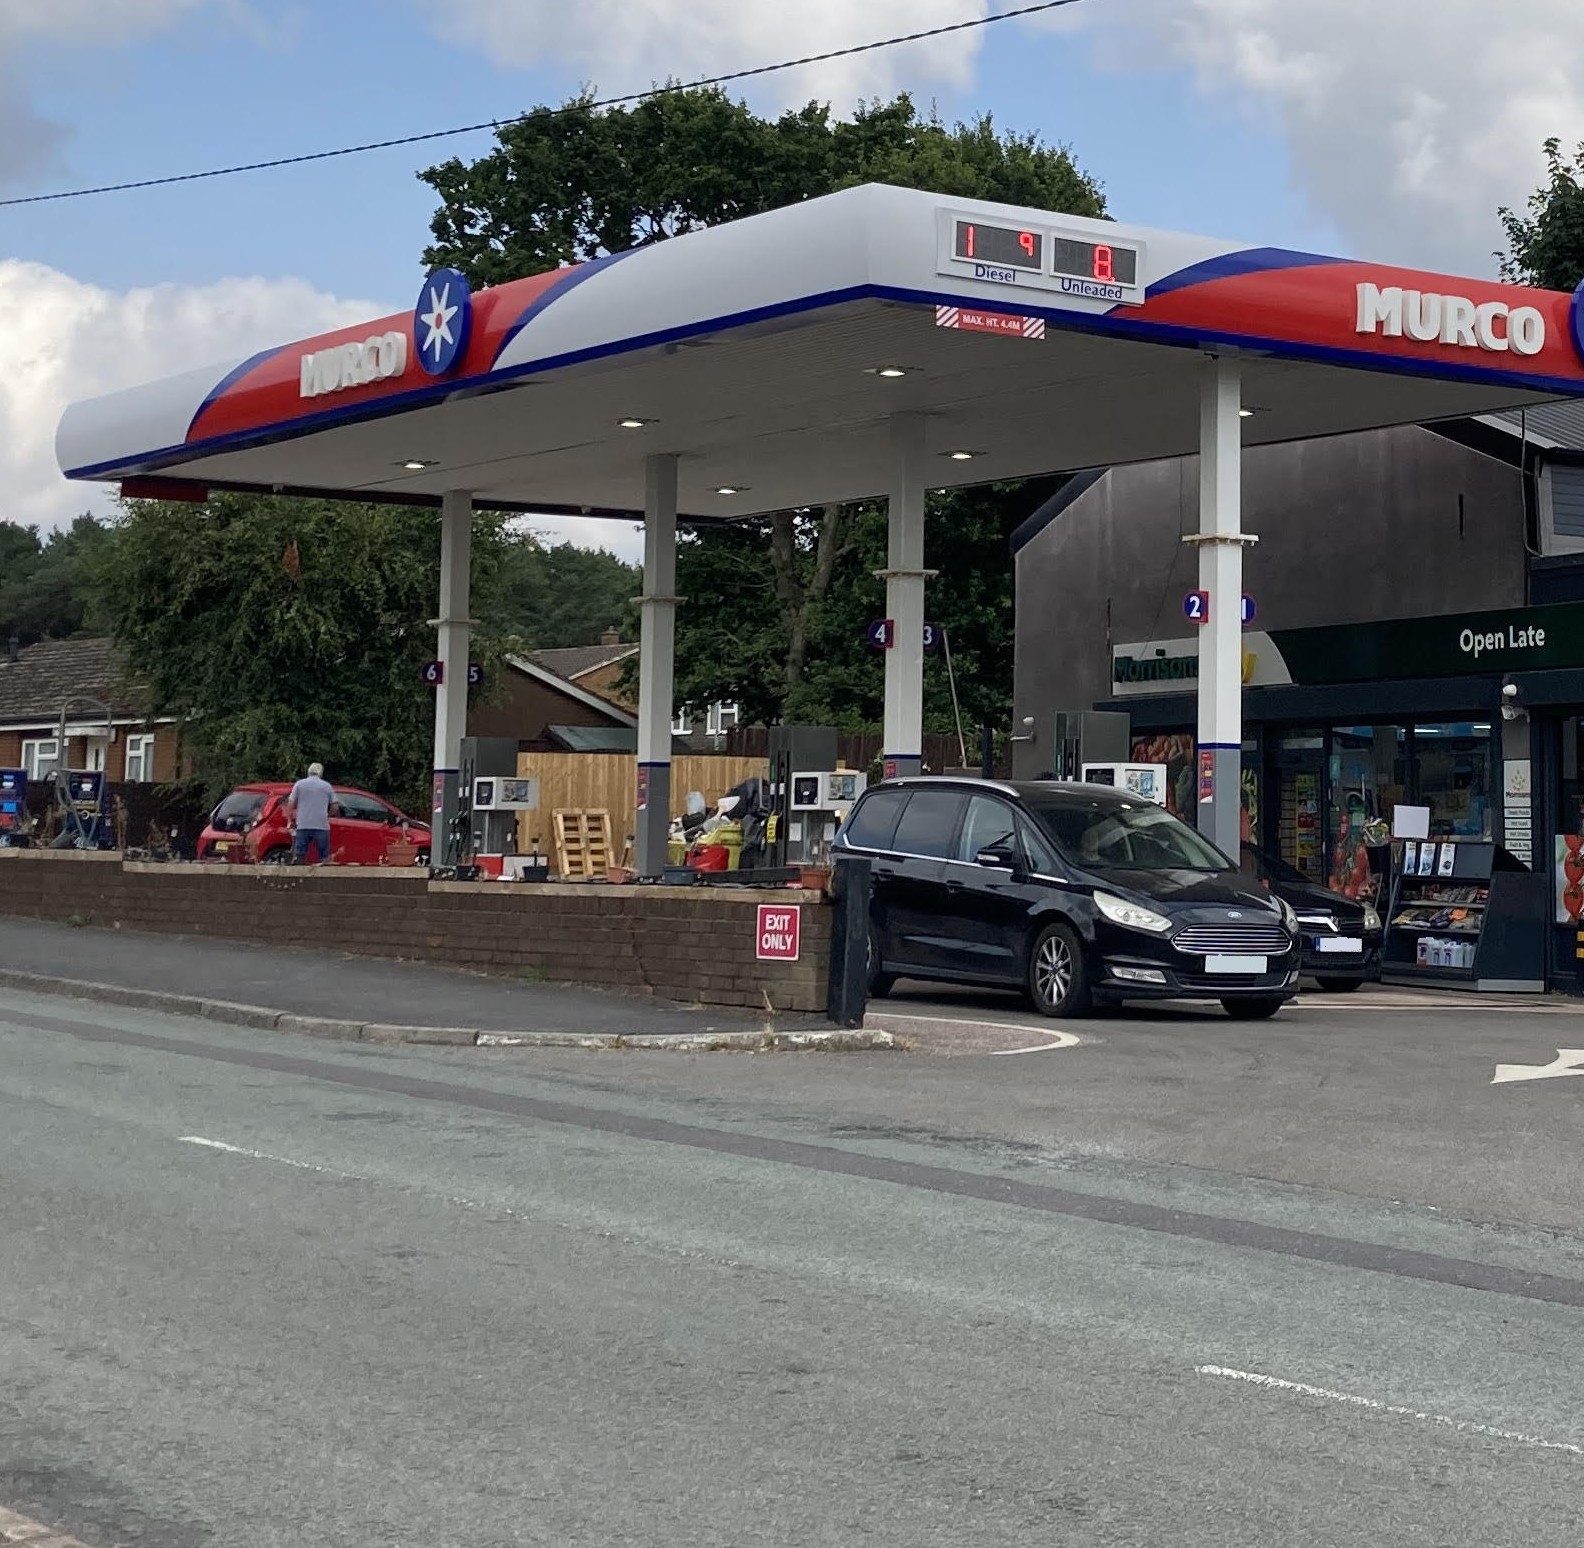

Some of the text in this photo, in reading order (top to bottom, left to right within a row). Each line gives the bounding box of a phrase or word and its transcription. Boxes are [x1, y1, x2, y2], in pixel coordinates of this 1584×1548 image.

[975, 264, 1016, 283] Diesel
[1061, 278, 1123, 299] Unleaded
[1355, 282, 1546, 356] MURCO
[300, 331, 407, 398] MURCO
[1189, 595, 1201, 618] 2
[874, 624, 886, 643] 4
[923, 625, 933, 645] 3
[1460, 625, 1545, 658] Open Late
[426, 664, 437, 680] 6
[469, 666, 479, 682] 5
[1114, 649, 1199, 683] Morrison
[765, 914, 791, 931] EXIT
[761, 933, 794, 951] ONLY
